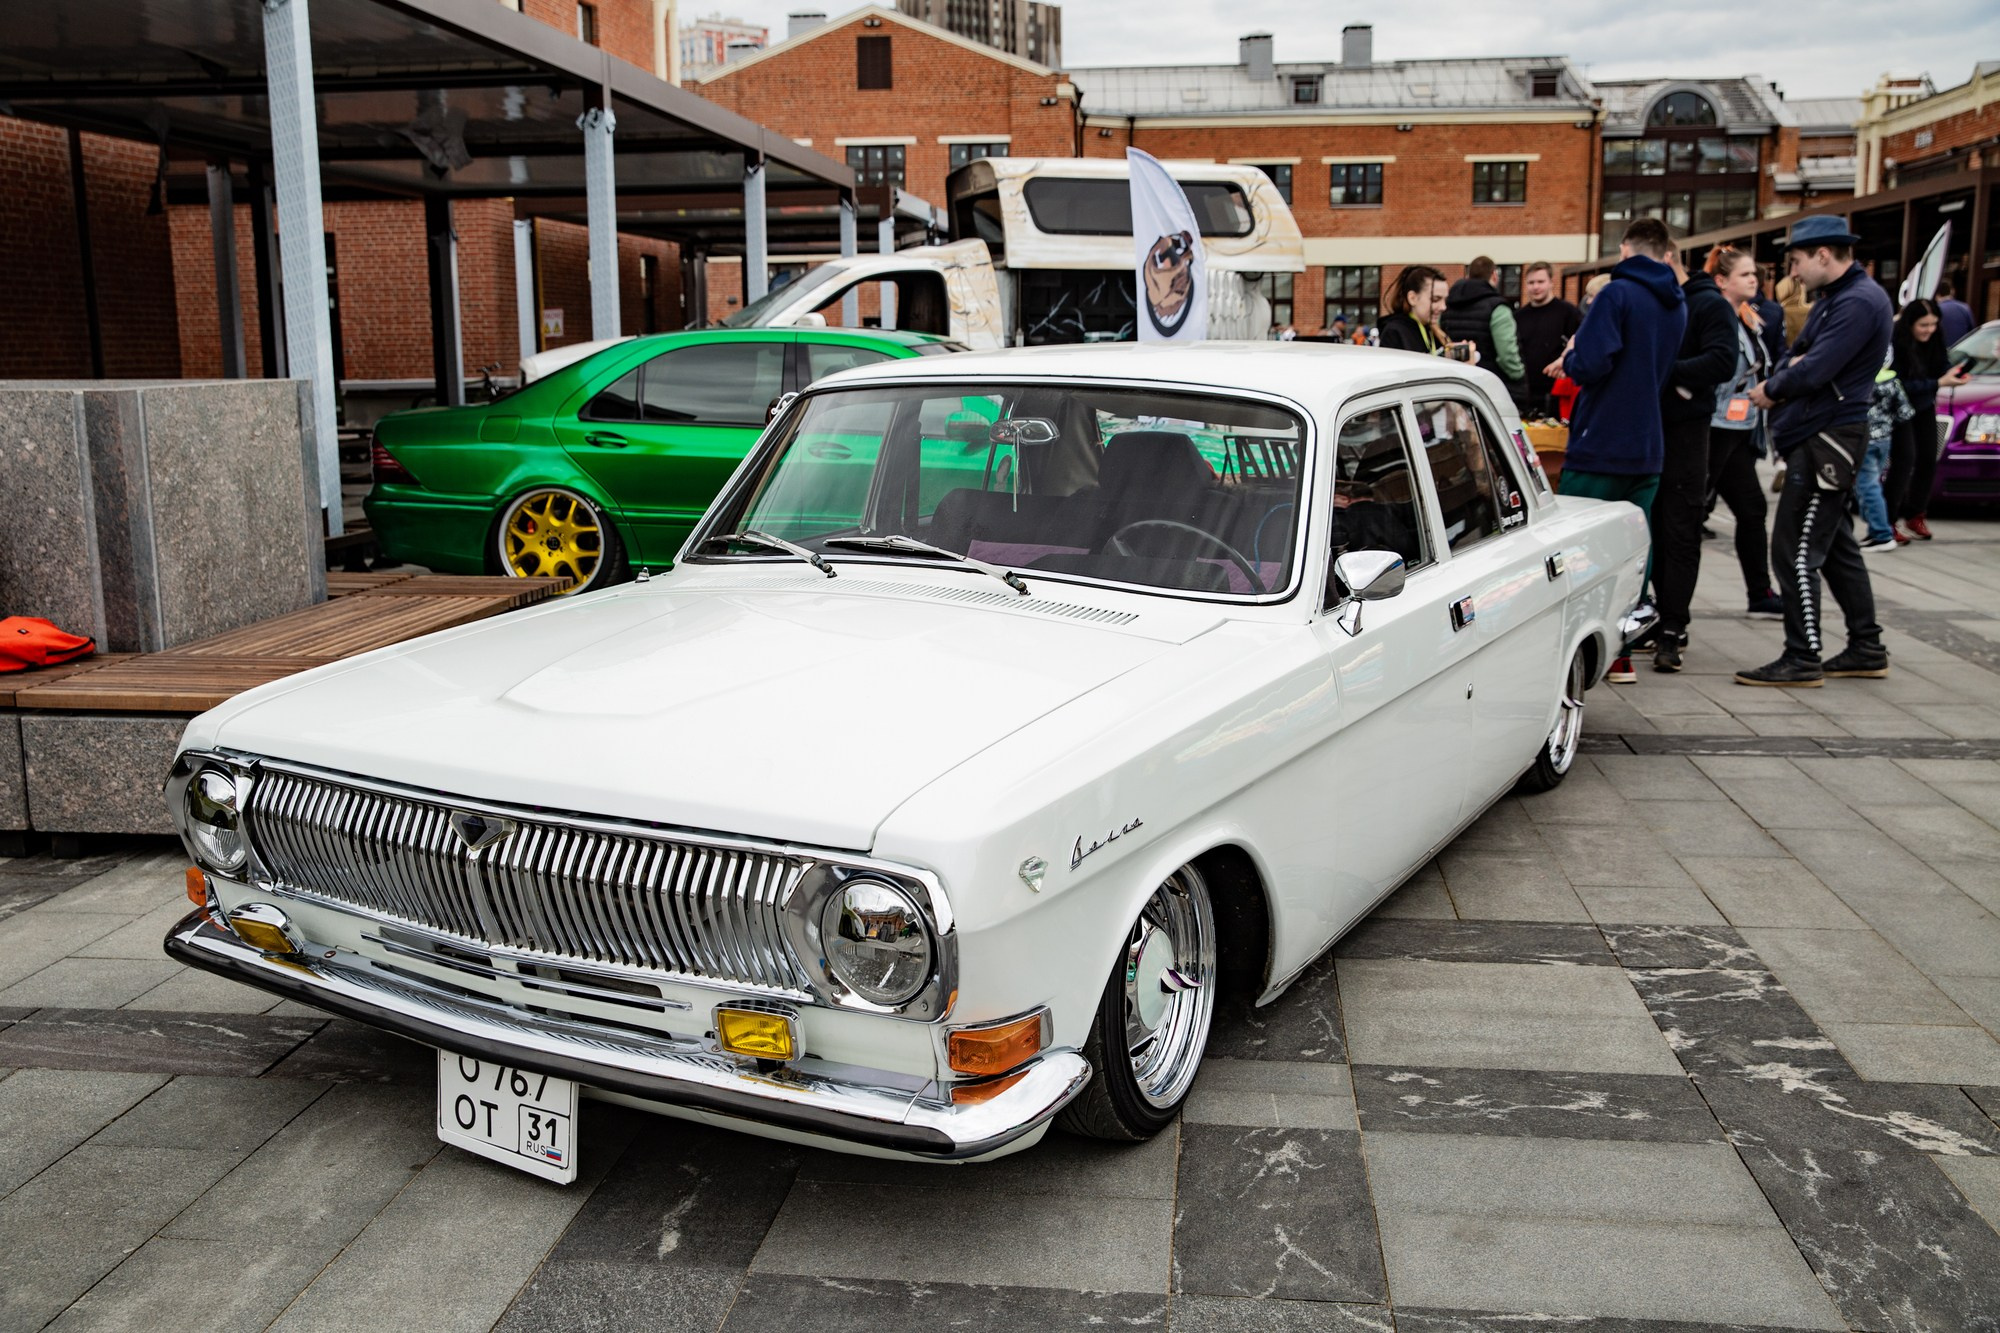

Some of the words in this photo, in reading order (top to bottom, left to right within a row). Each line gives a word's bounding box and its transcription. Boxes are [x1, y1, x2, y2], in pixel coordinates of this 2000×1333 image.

[454, 1093, 499, 1138] ОТ
[527, 1112, 557, 1147] 31
[526, 1140, 546, 1156] RUS
